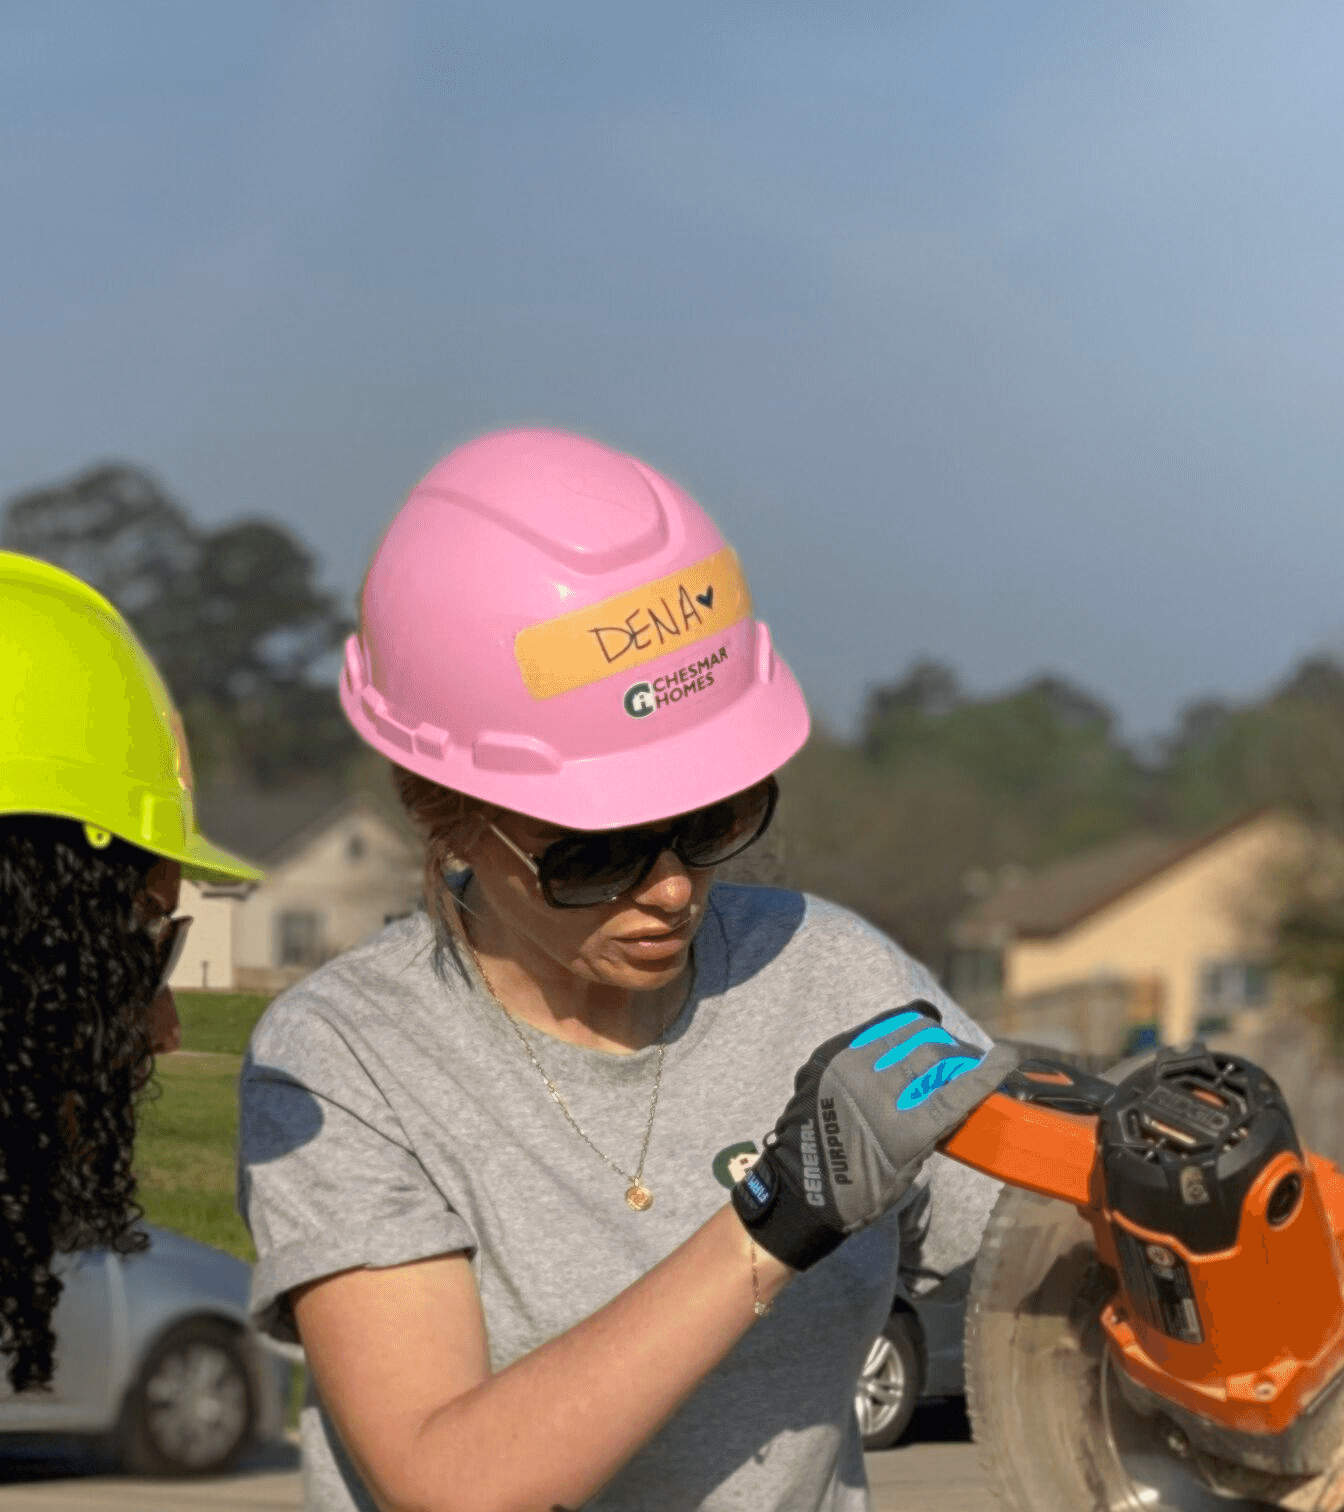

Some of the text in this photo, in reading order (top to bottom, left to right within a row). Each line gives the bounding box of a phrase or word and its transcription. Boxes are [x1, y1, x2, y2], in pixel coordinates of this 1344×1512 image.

[587, 584, 703, 663] DENA
[653, 646, 729, 693] CHESMAR
[655, 671, 715, 709] HOMES
[800, 1118, 825, 1207] GENERAL
[820, 1097, 854, 1185] PURPOSE
